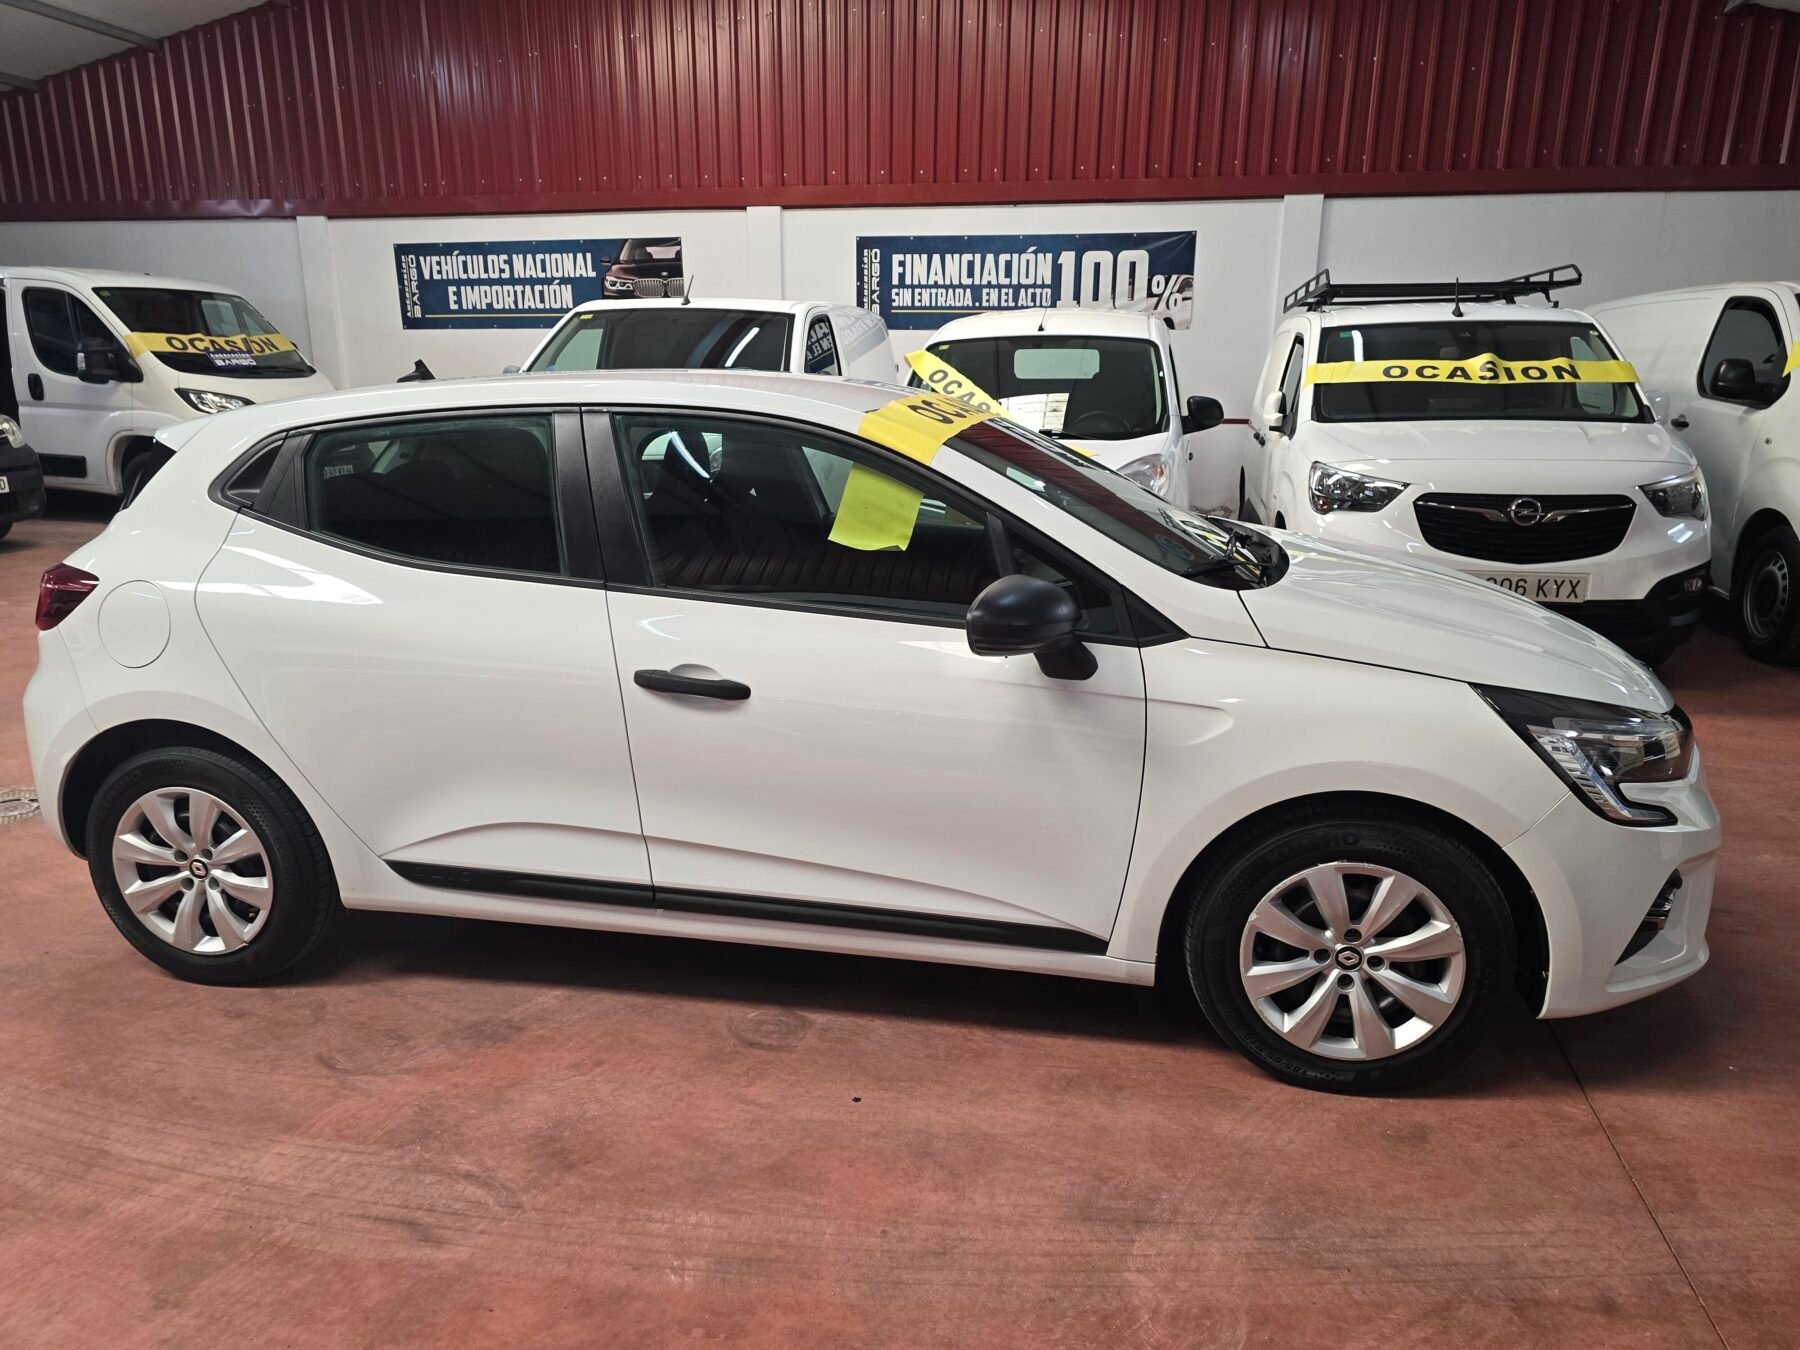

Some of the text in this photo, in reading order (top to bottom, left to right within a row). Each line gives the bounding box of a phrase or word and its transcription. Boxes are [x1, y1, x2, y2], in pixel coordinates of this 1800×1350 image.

[419, 250, 597, 280] VEHÍCULOS NACIONAL
[891, 246, 1053, 286] FINANCIACIÓN
[408, 254, 422, 318] BARGO
[447, 279, 574, 310] E IMPORTACIÓN
[891, 288, 912, 307] SIN
[982, 287, 999, 307] EN
[1000, 287, 1016, 307] EL
[1017, 287, 1052, 307] ACTO
[1382, 360, 1581, 381] OCASION
[928, 369, 994, 414] OCAS
[1535, 578, 1581, 599] KYX
